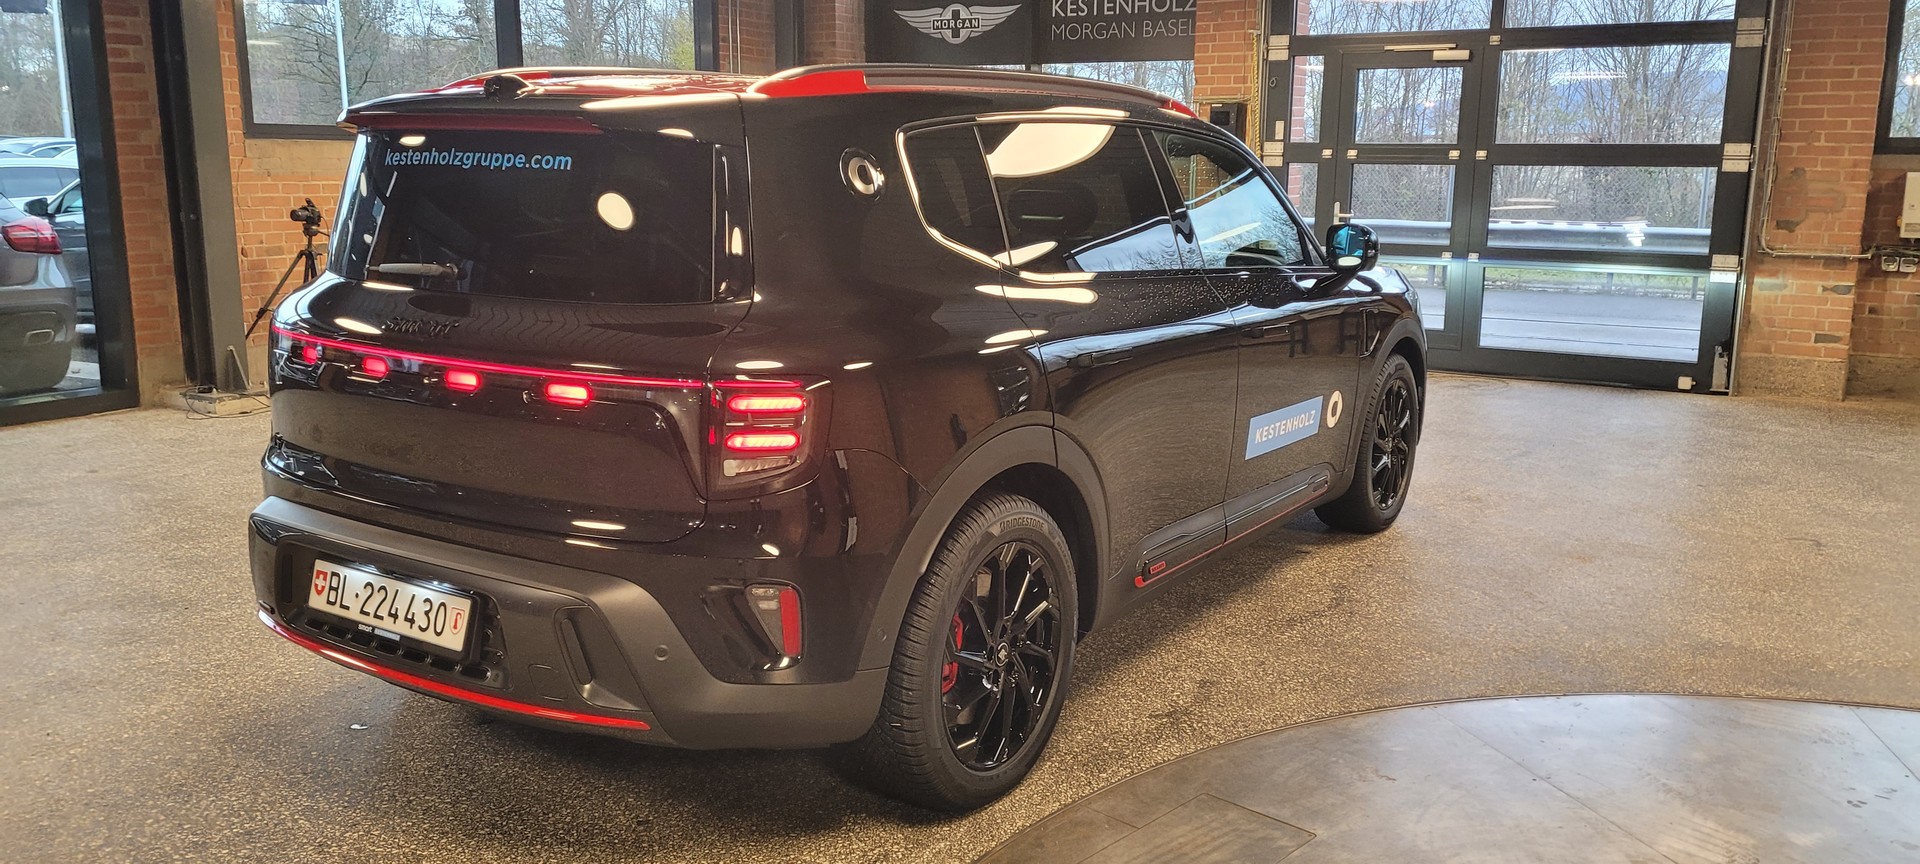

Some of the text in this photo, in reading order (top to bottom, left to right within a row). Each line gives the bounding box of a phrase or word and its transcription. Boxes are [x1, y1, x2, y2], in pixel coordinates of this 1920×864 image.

[1052, 0, 1197, 17] KESTENHOLZ
[933, 19, 979, 29] MORGAN
[1051, 19, 1196, 41] MORGAN BASEL
[385, 147, 572, 170] kestenholzgruppe.com
[1255, 410, 1316, 444] KESTENHOLZ
[999, 516, 1045, 534] BRIDGESTONE
